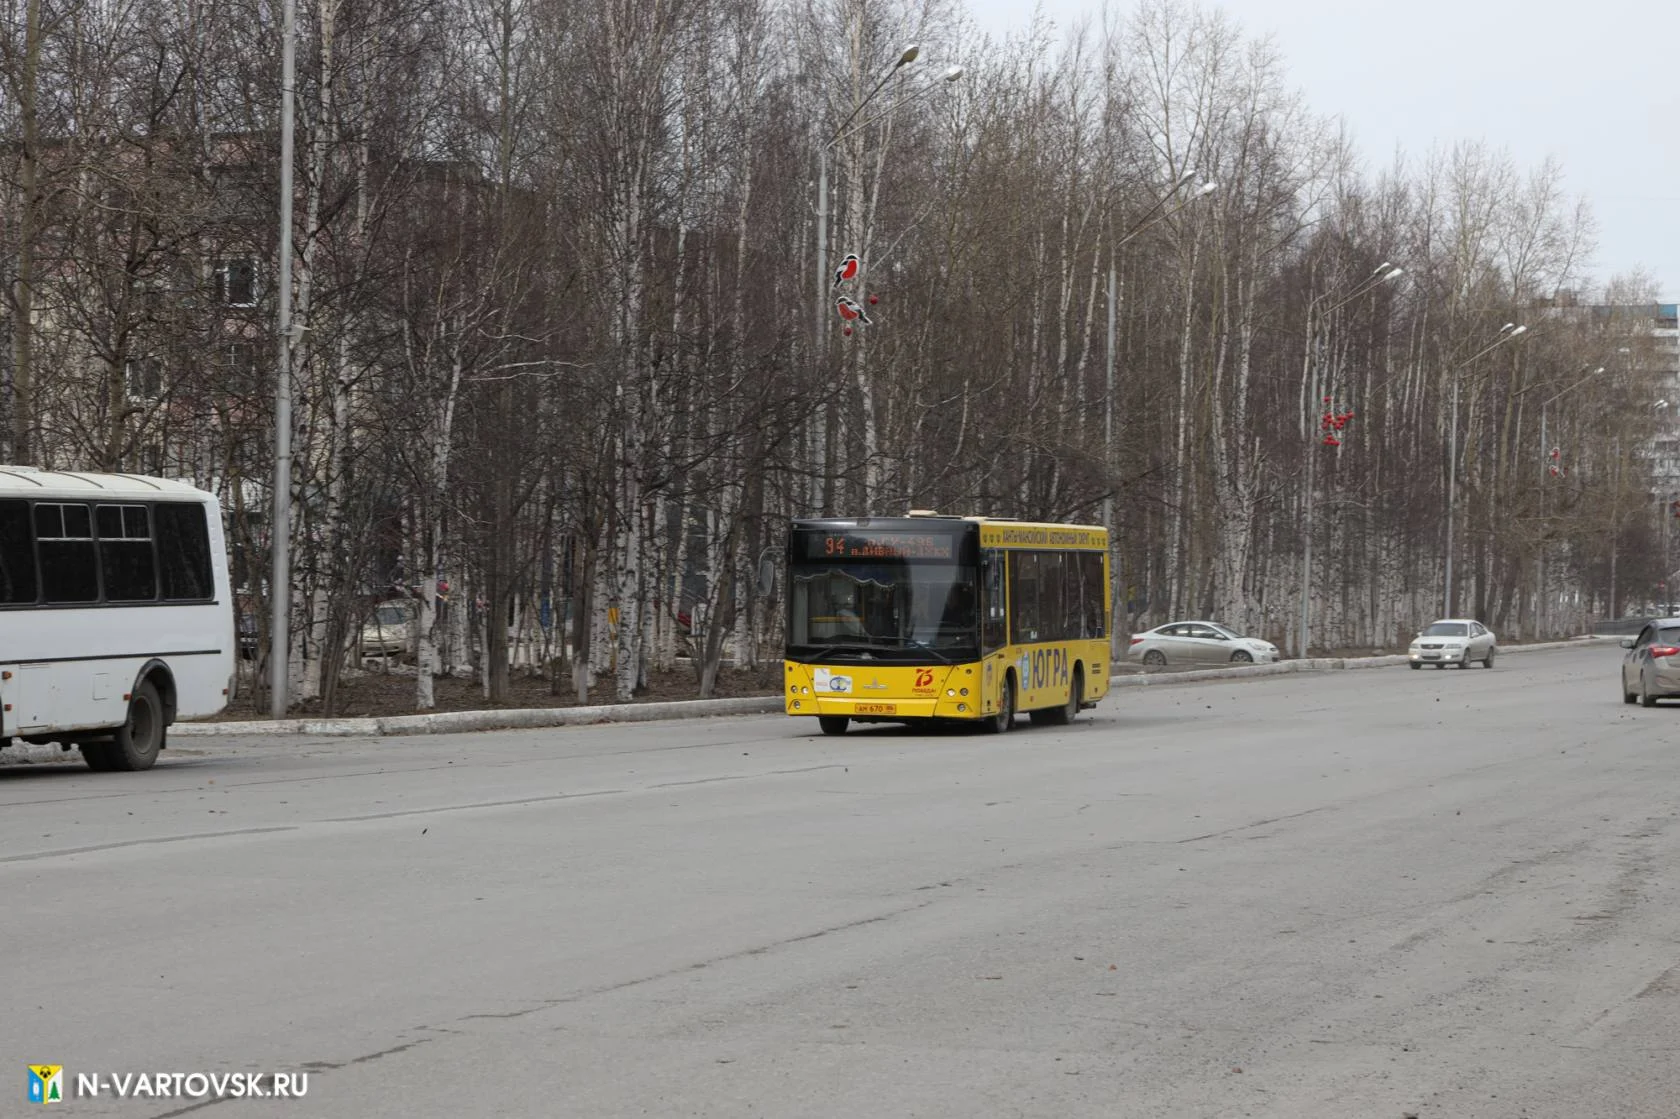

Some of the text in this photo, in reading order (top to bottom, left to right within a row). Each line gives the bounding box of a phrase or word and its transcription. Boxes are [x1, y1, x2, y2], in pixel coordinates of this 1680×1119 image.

[915, 668, 933, 687] 75
[1032, 648, 1068, 688] ЮГРА
[869, 705, 884, 713] 670
